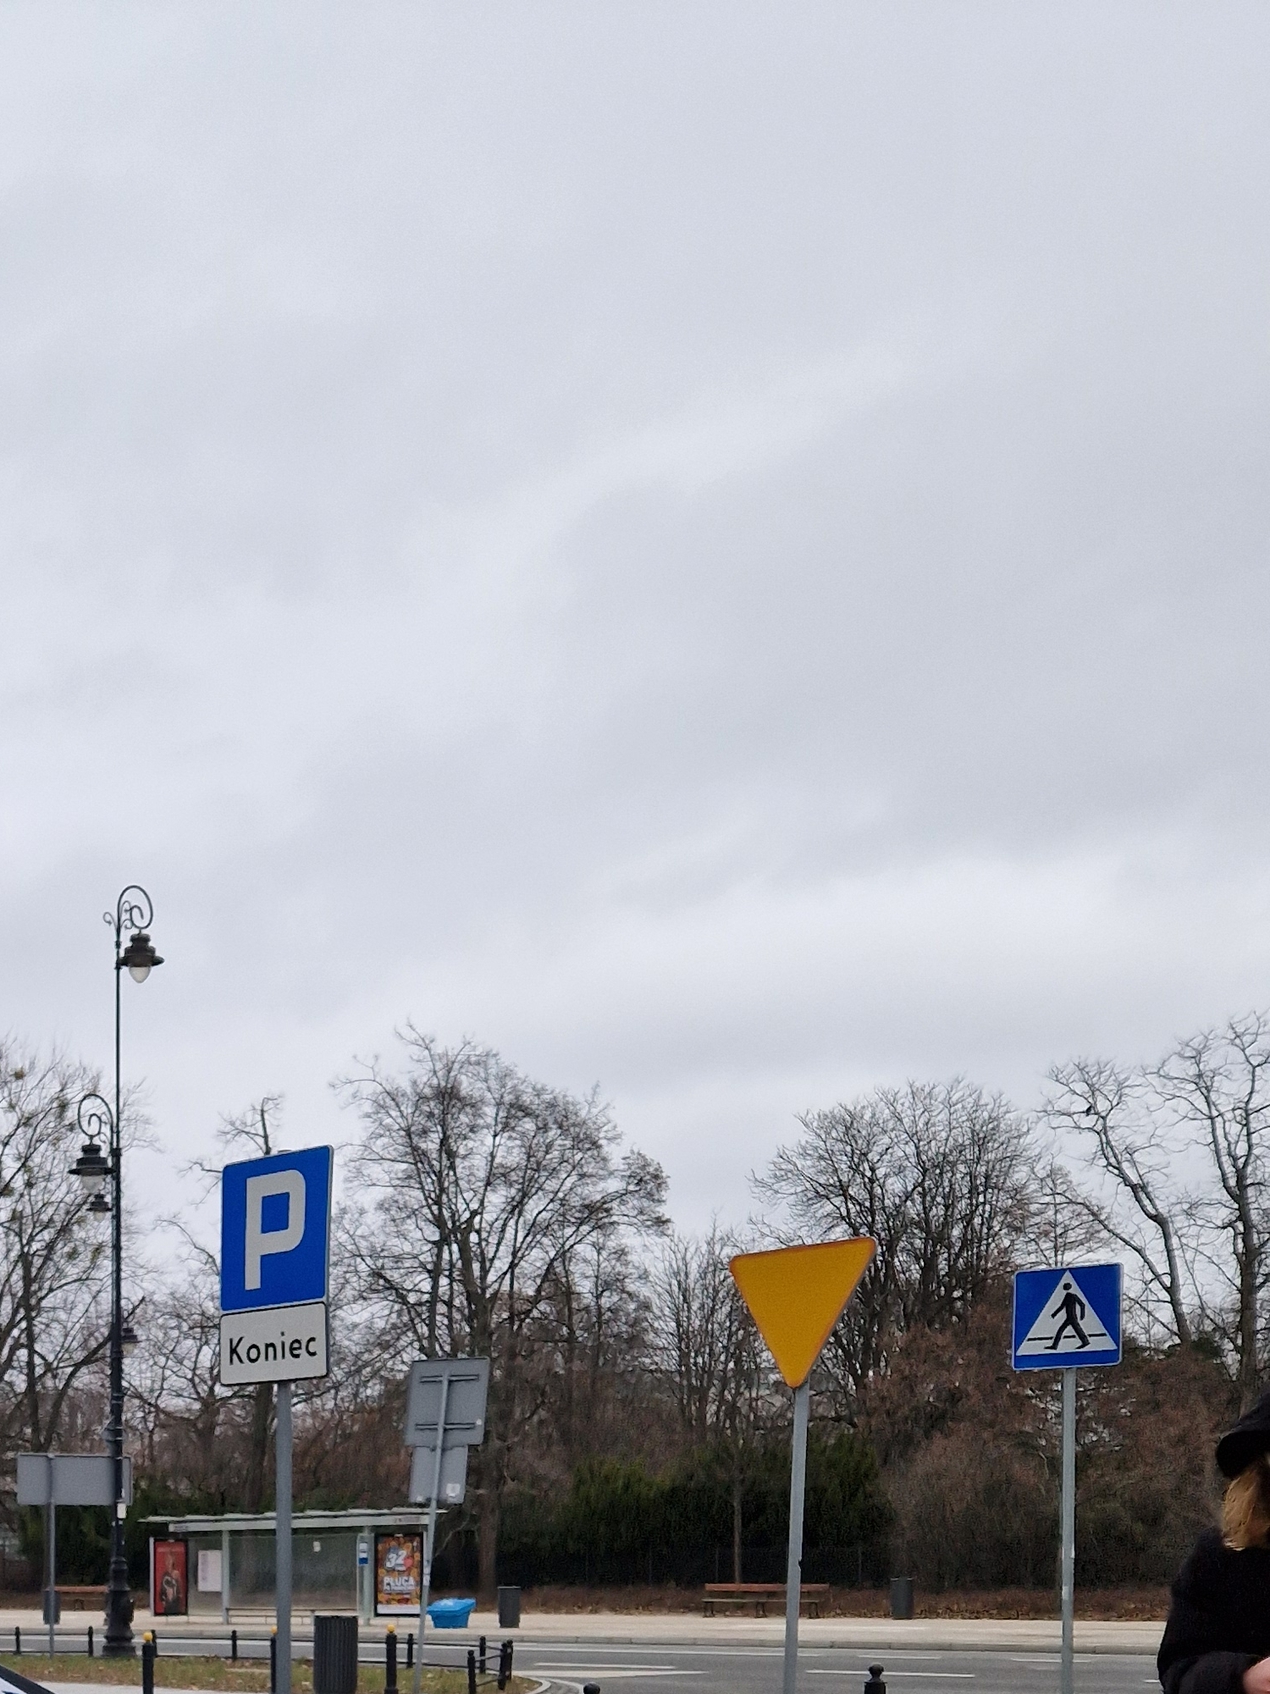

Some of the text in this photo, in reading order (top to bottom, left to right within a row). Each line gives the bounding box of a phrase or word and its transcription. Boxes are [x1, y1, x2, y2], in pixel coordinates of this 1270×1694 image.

[245, 1169, 306, 1291] P
[228, 1330, 318, 1366] Koniec
[385, 1550, 407, 1568] 32
